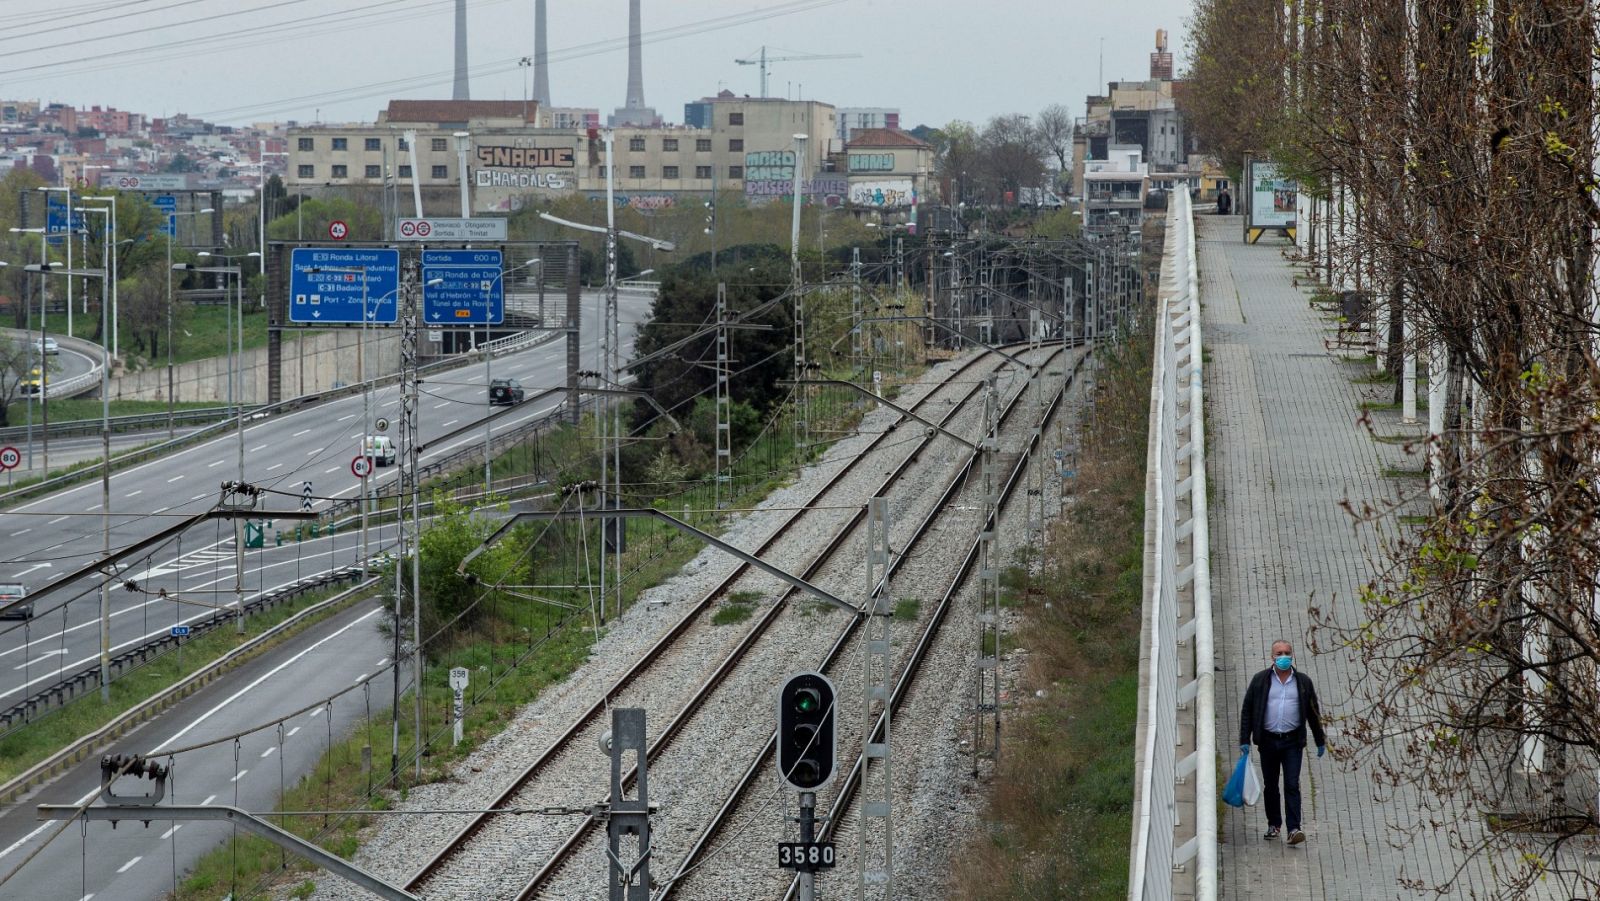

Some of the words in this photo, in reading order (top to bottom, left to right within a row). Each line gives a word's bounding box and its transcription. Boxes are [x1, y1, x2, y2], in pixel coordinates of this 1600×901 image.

[477, 146, 575, 168] SNAQUE
[330, 253, 353, 261] Ronda
[355, 253, 378, 261] Litoral
[474, 254, 489, 262] 600
[364, 264, 395, 272] ndustrial
[479, 291, 500, 299] Sarià
[323, 296, 339, 304] Port
[3, 454, 16, 462] 80
[452, 670, 466, 678] 358
[780, 846, 834, 864] 3580
